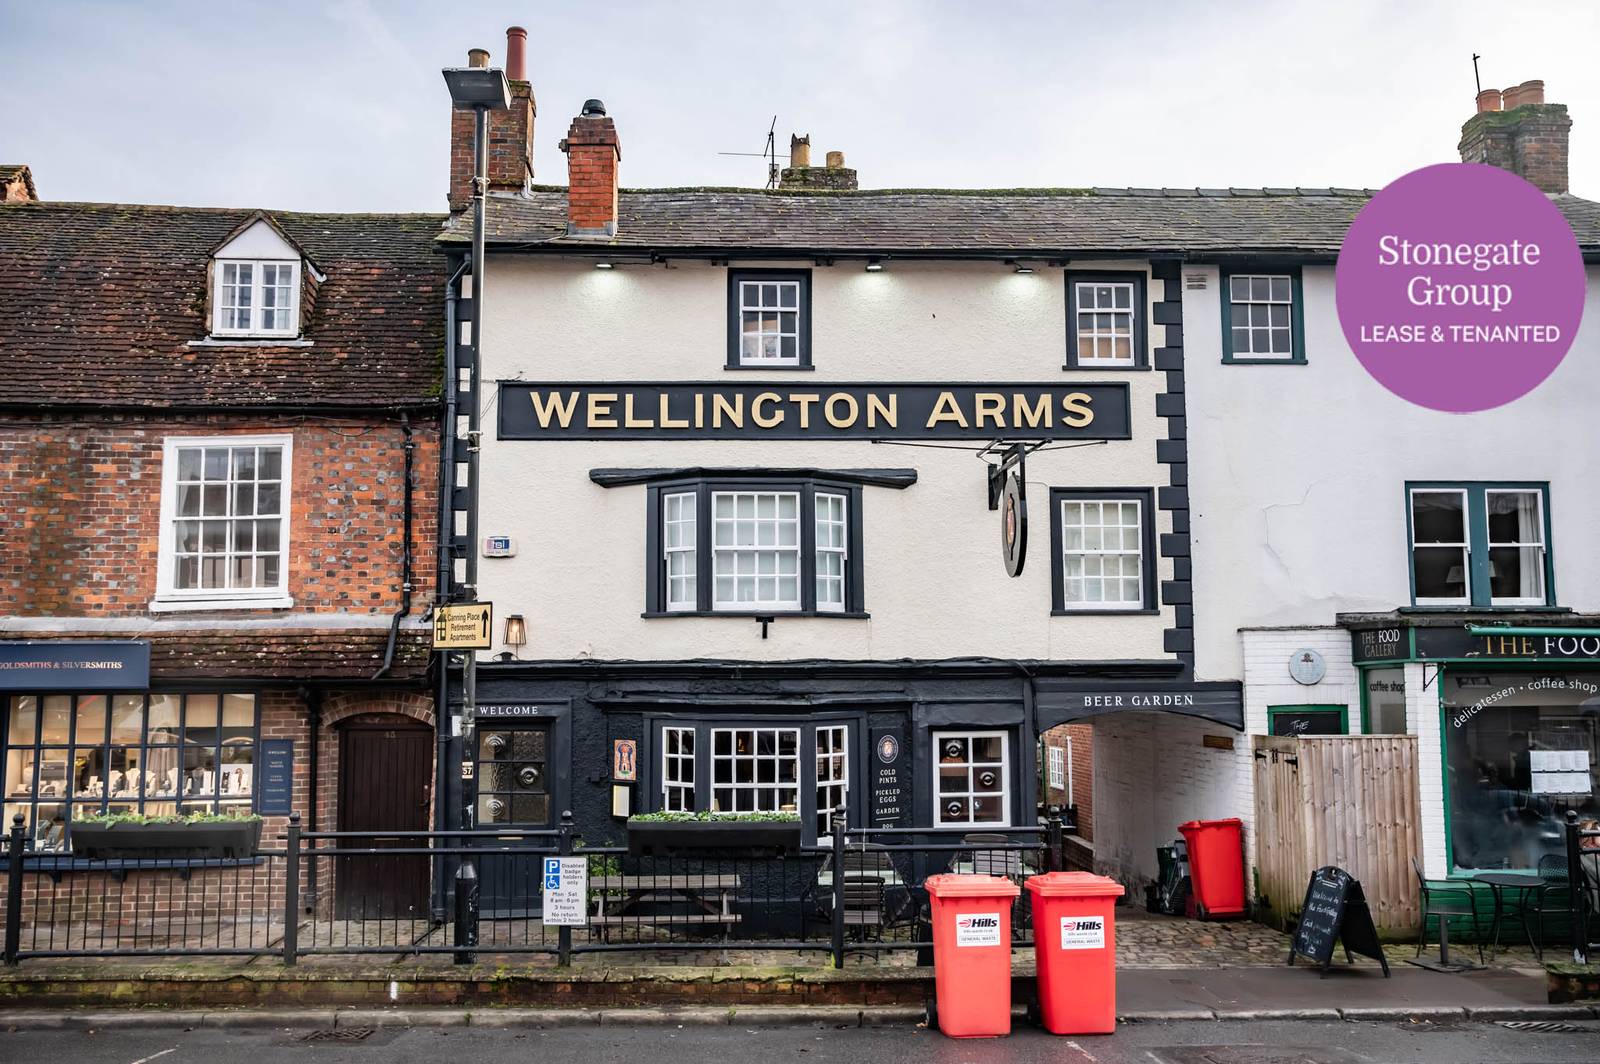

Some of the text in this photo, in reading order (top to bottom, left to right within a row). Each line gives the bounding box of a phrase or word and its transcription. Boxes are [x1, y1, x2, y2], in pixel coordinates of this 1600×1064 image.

[530, 391, 1094, 428] WELLINGTON ARMS
[447, 612, 480, 623] Canning Place
[450, 623, 476, 632] Retirement
[450, 633, 476, 642] Apartments
[1361, 629, 1400, 644] THE FOOD
[1364, 643, 1397, 657] GALLERY
[1481, 635, 1536, 655] THE
[53, 661, 60, 669] &
[62, 661, 122, 669] SILVERSMITHS
[1370, 681, 1404, 694] coffee shop
[1084, 694, 1194, 707] BEER GARDEN
[1453, 678, 1598, 728] delicatessen coffee shop
[480, 706, 538, 715] WELCOME
[1290, 719, 1310, 732] THE
[462, 767, 472, 775] 57
[879, 776, 897, 784] PINTS
[875, 788, 900, 796] PICKLED
[879, 796, 897, 804] EGGS
[875, 807, 900, 815] GARDEN
[549, 860, 558, 873] P
[971, 918, 998, 928] Hills
[1076, 921, 1102, 931] Hills
